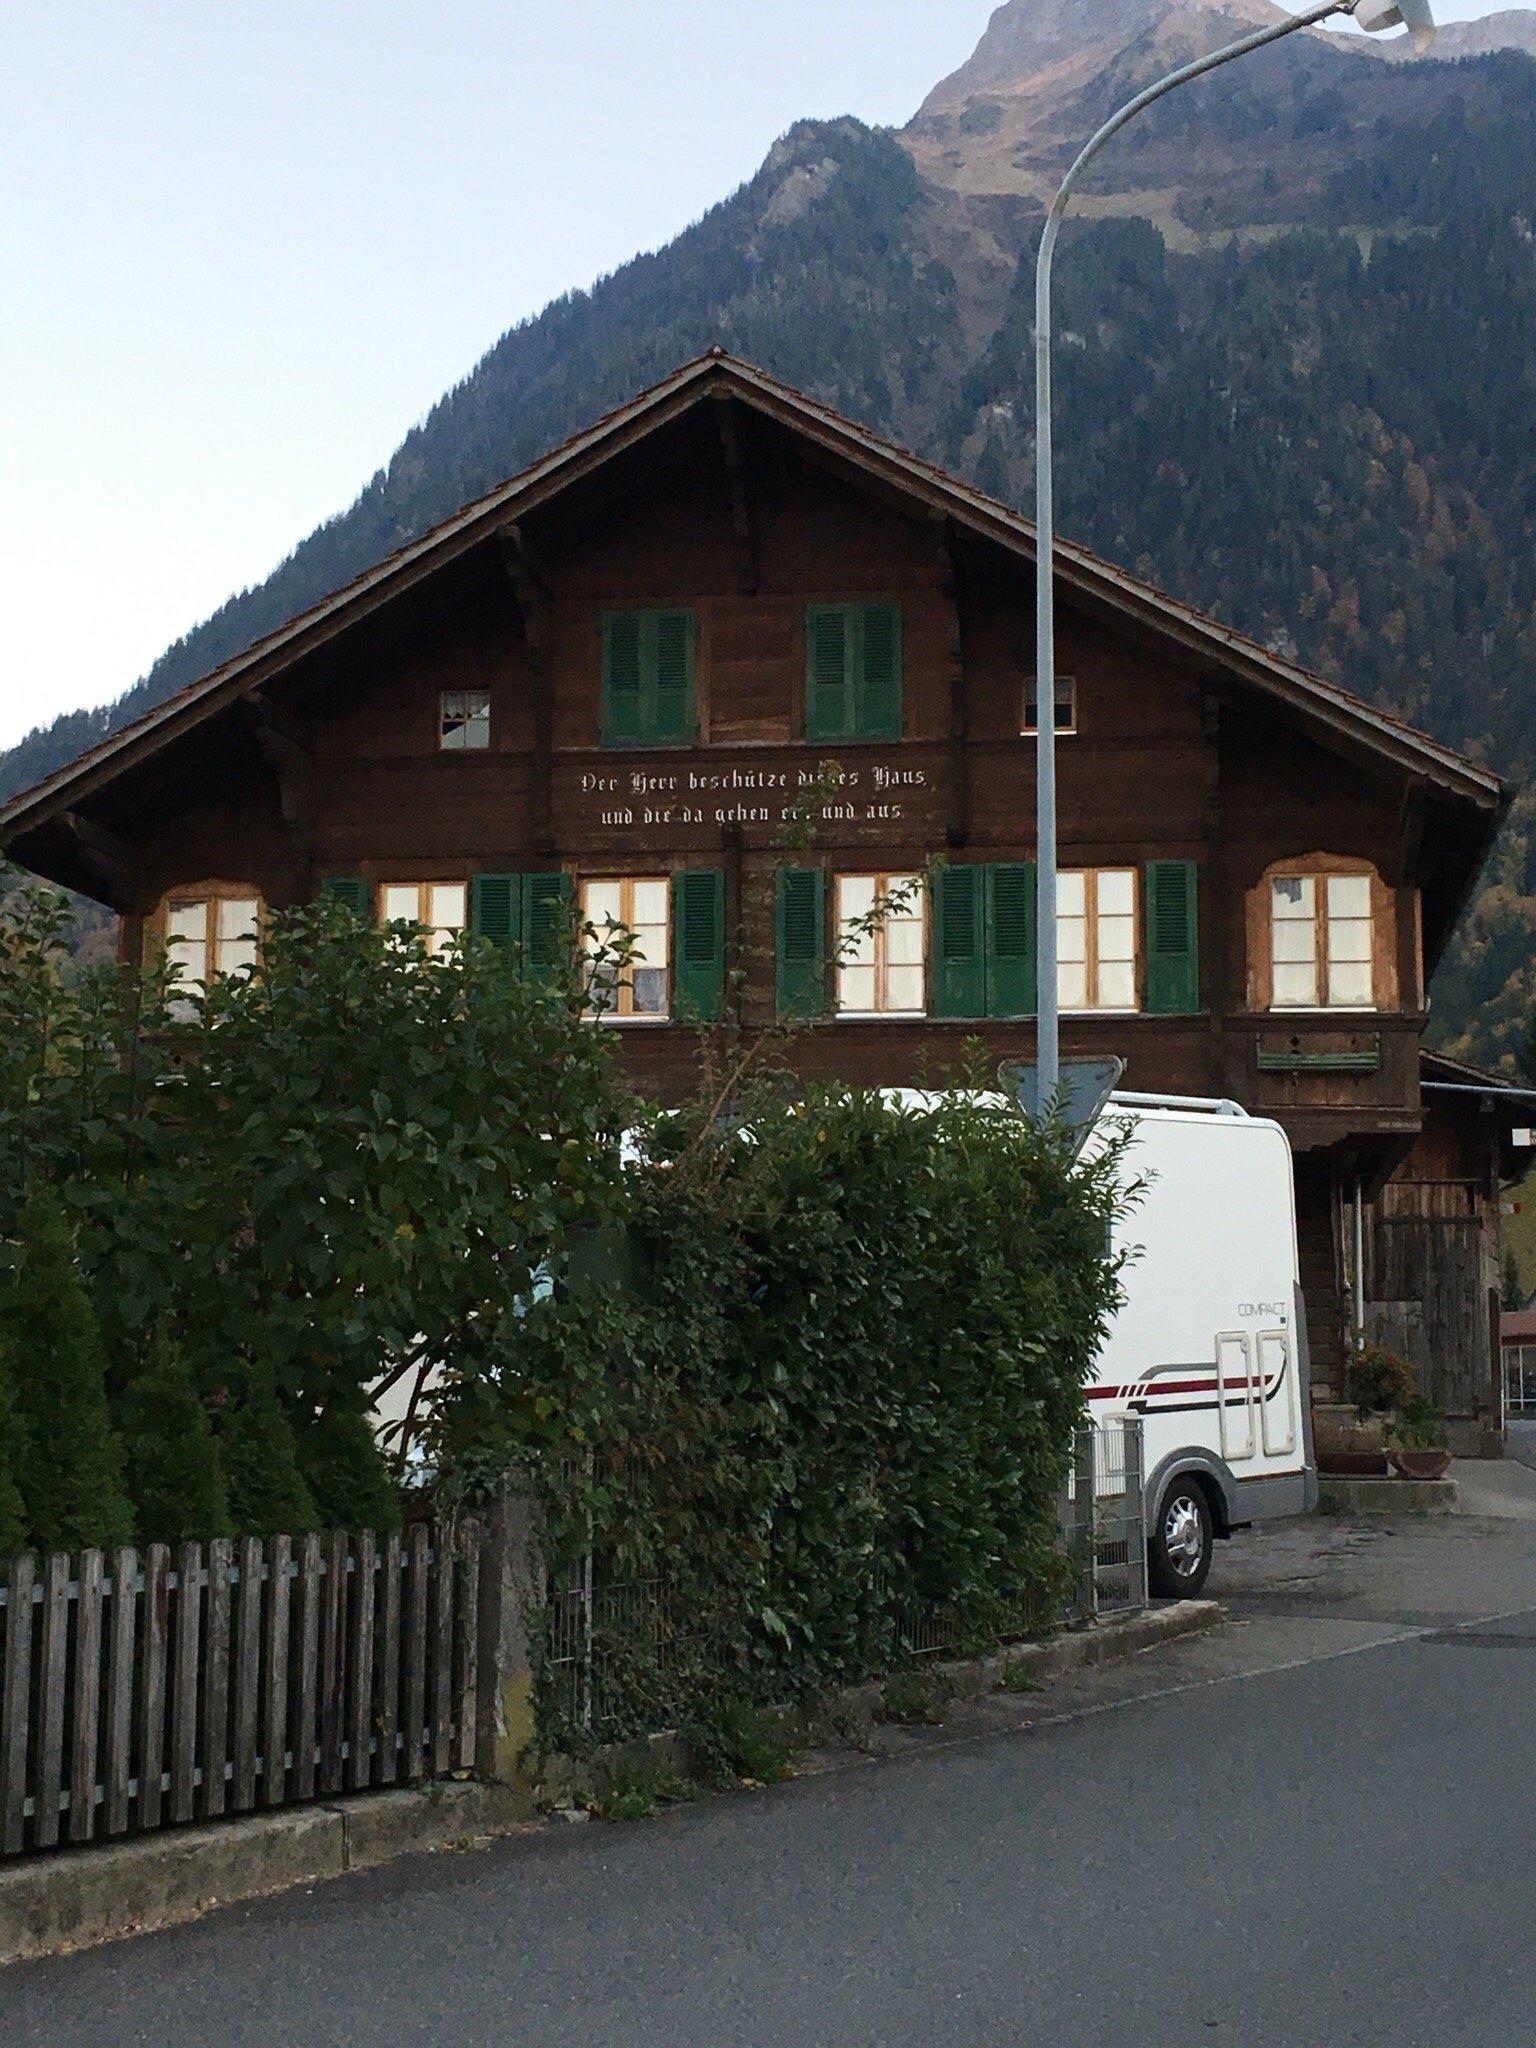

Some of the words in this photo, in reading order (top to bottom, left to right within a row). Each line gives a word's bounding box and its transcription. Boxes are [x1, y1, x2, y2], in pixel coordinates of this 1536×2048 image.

[581, 772, 618, 792] Der
[629, 772, 677, 795] Herr
[689, 769, 787, 790] beschütze
[798, 769, 860, 787] diees
[601, 807, 634, 825] und
[644, 805, 671, 824] die
[683, 805, 703, 823] da
[715, 803, 769, 827] gehen
[781, 806, 811, 820] ei
[822, 801, 855, 820] und
[1237, 1302, 1286, 1316] COMPACT
